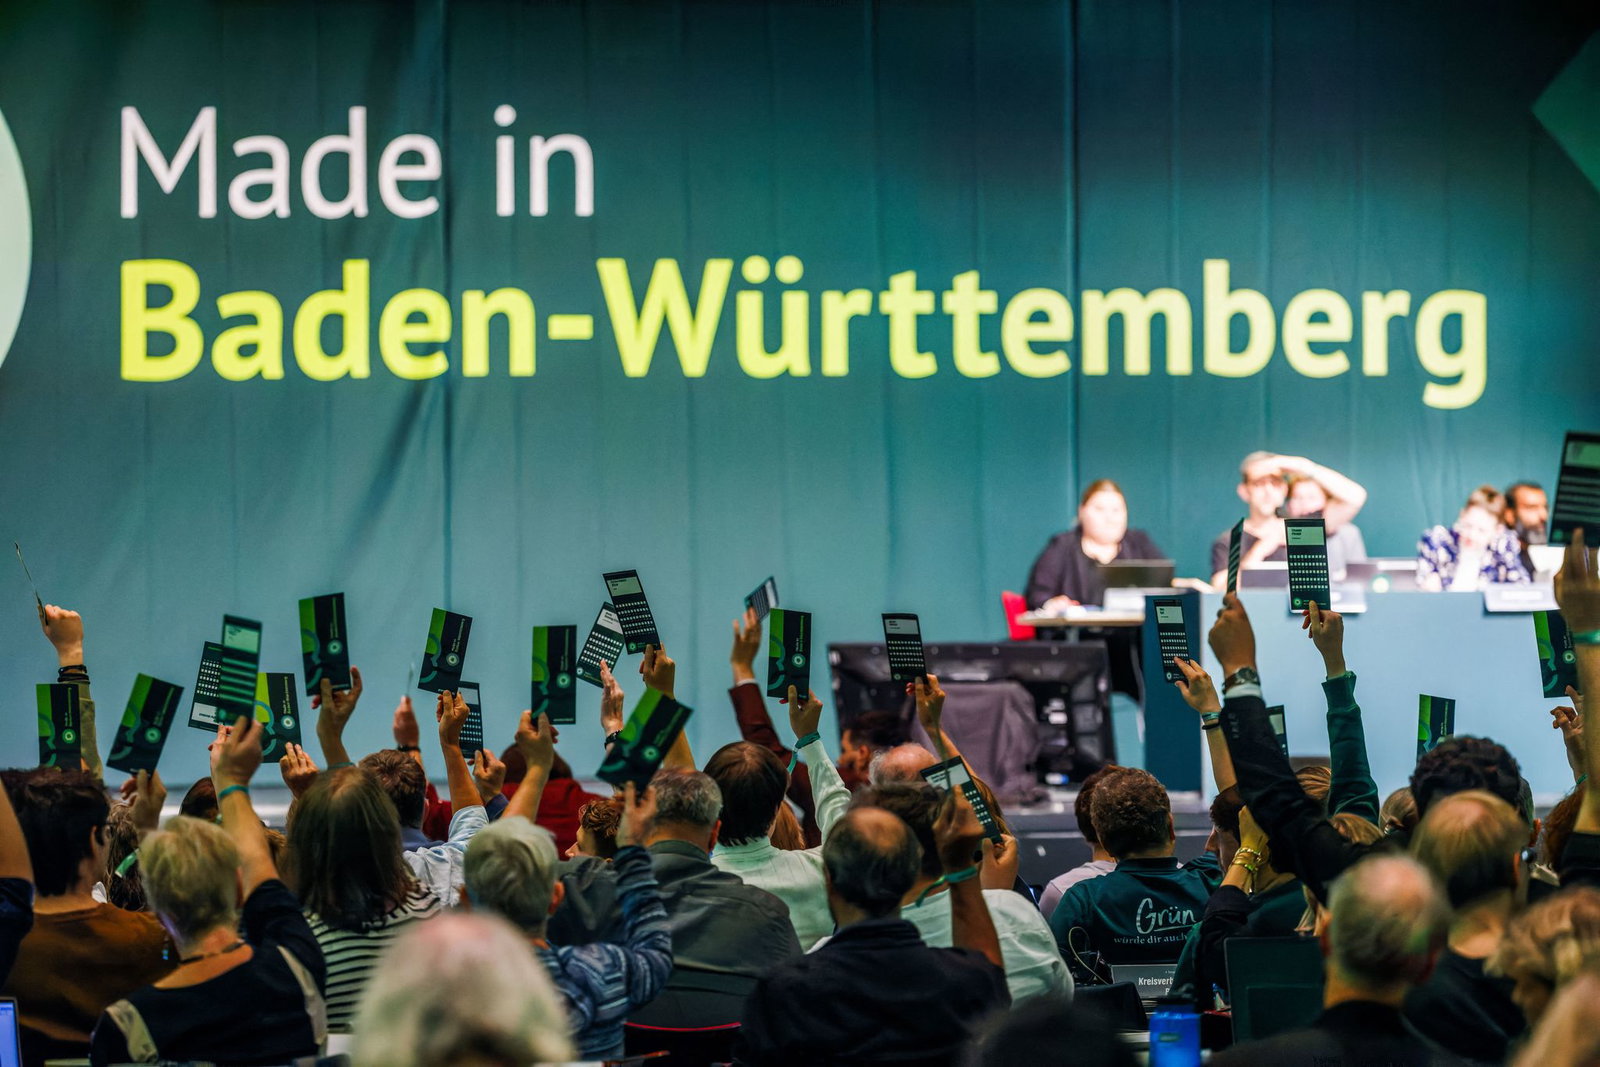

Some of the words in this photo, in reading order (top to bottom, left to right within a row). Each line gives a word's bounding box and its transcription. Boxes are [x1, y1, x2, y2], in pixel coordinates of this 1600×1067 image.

[119, 105, 442, 220] Made
[494, 104, 595, 218] in
[119, 255, 1488, 410] Baden-Württemberg
[1136, 897, 1196, 934] Grün
[1147, 935, 1162, 944] dir
